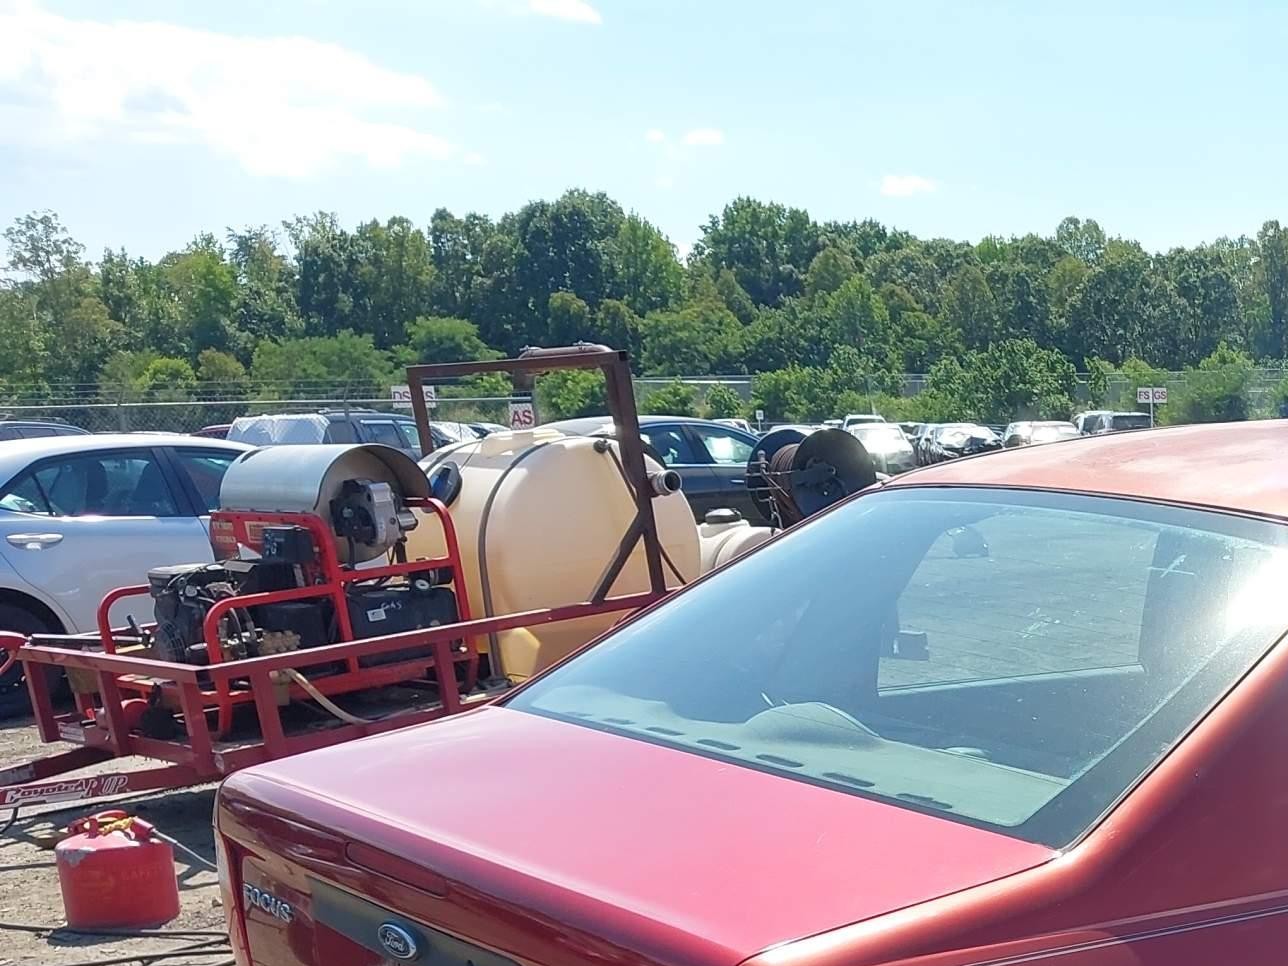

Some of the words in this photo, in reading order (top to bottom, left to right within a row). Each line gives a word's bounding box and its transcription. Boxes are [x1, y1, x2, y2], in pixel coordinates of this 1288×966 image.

[1153, 391, 1167, 400] GS
[511, 409, 533, 426] AS
[243, 883, 292, 923] FOCUS
